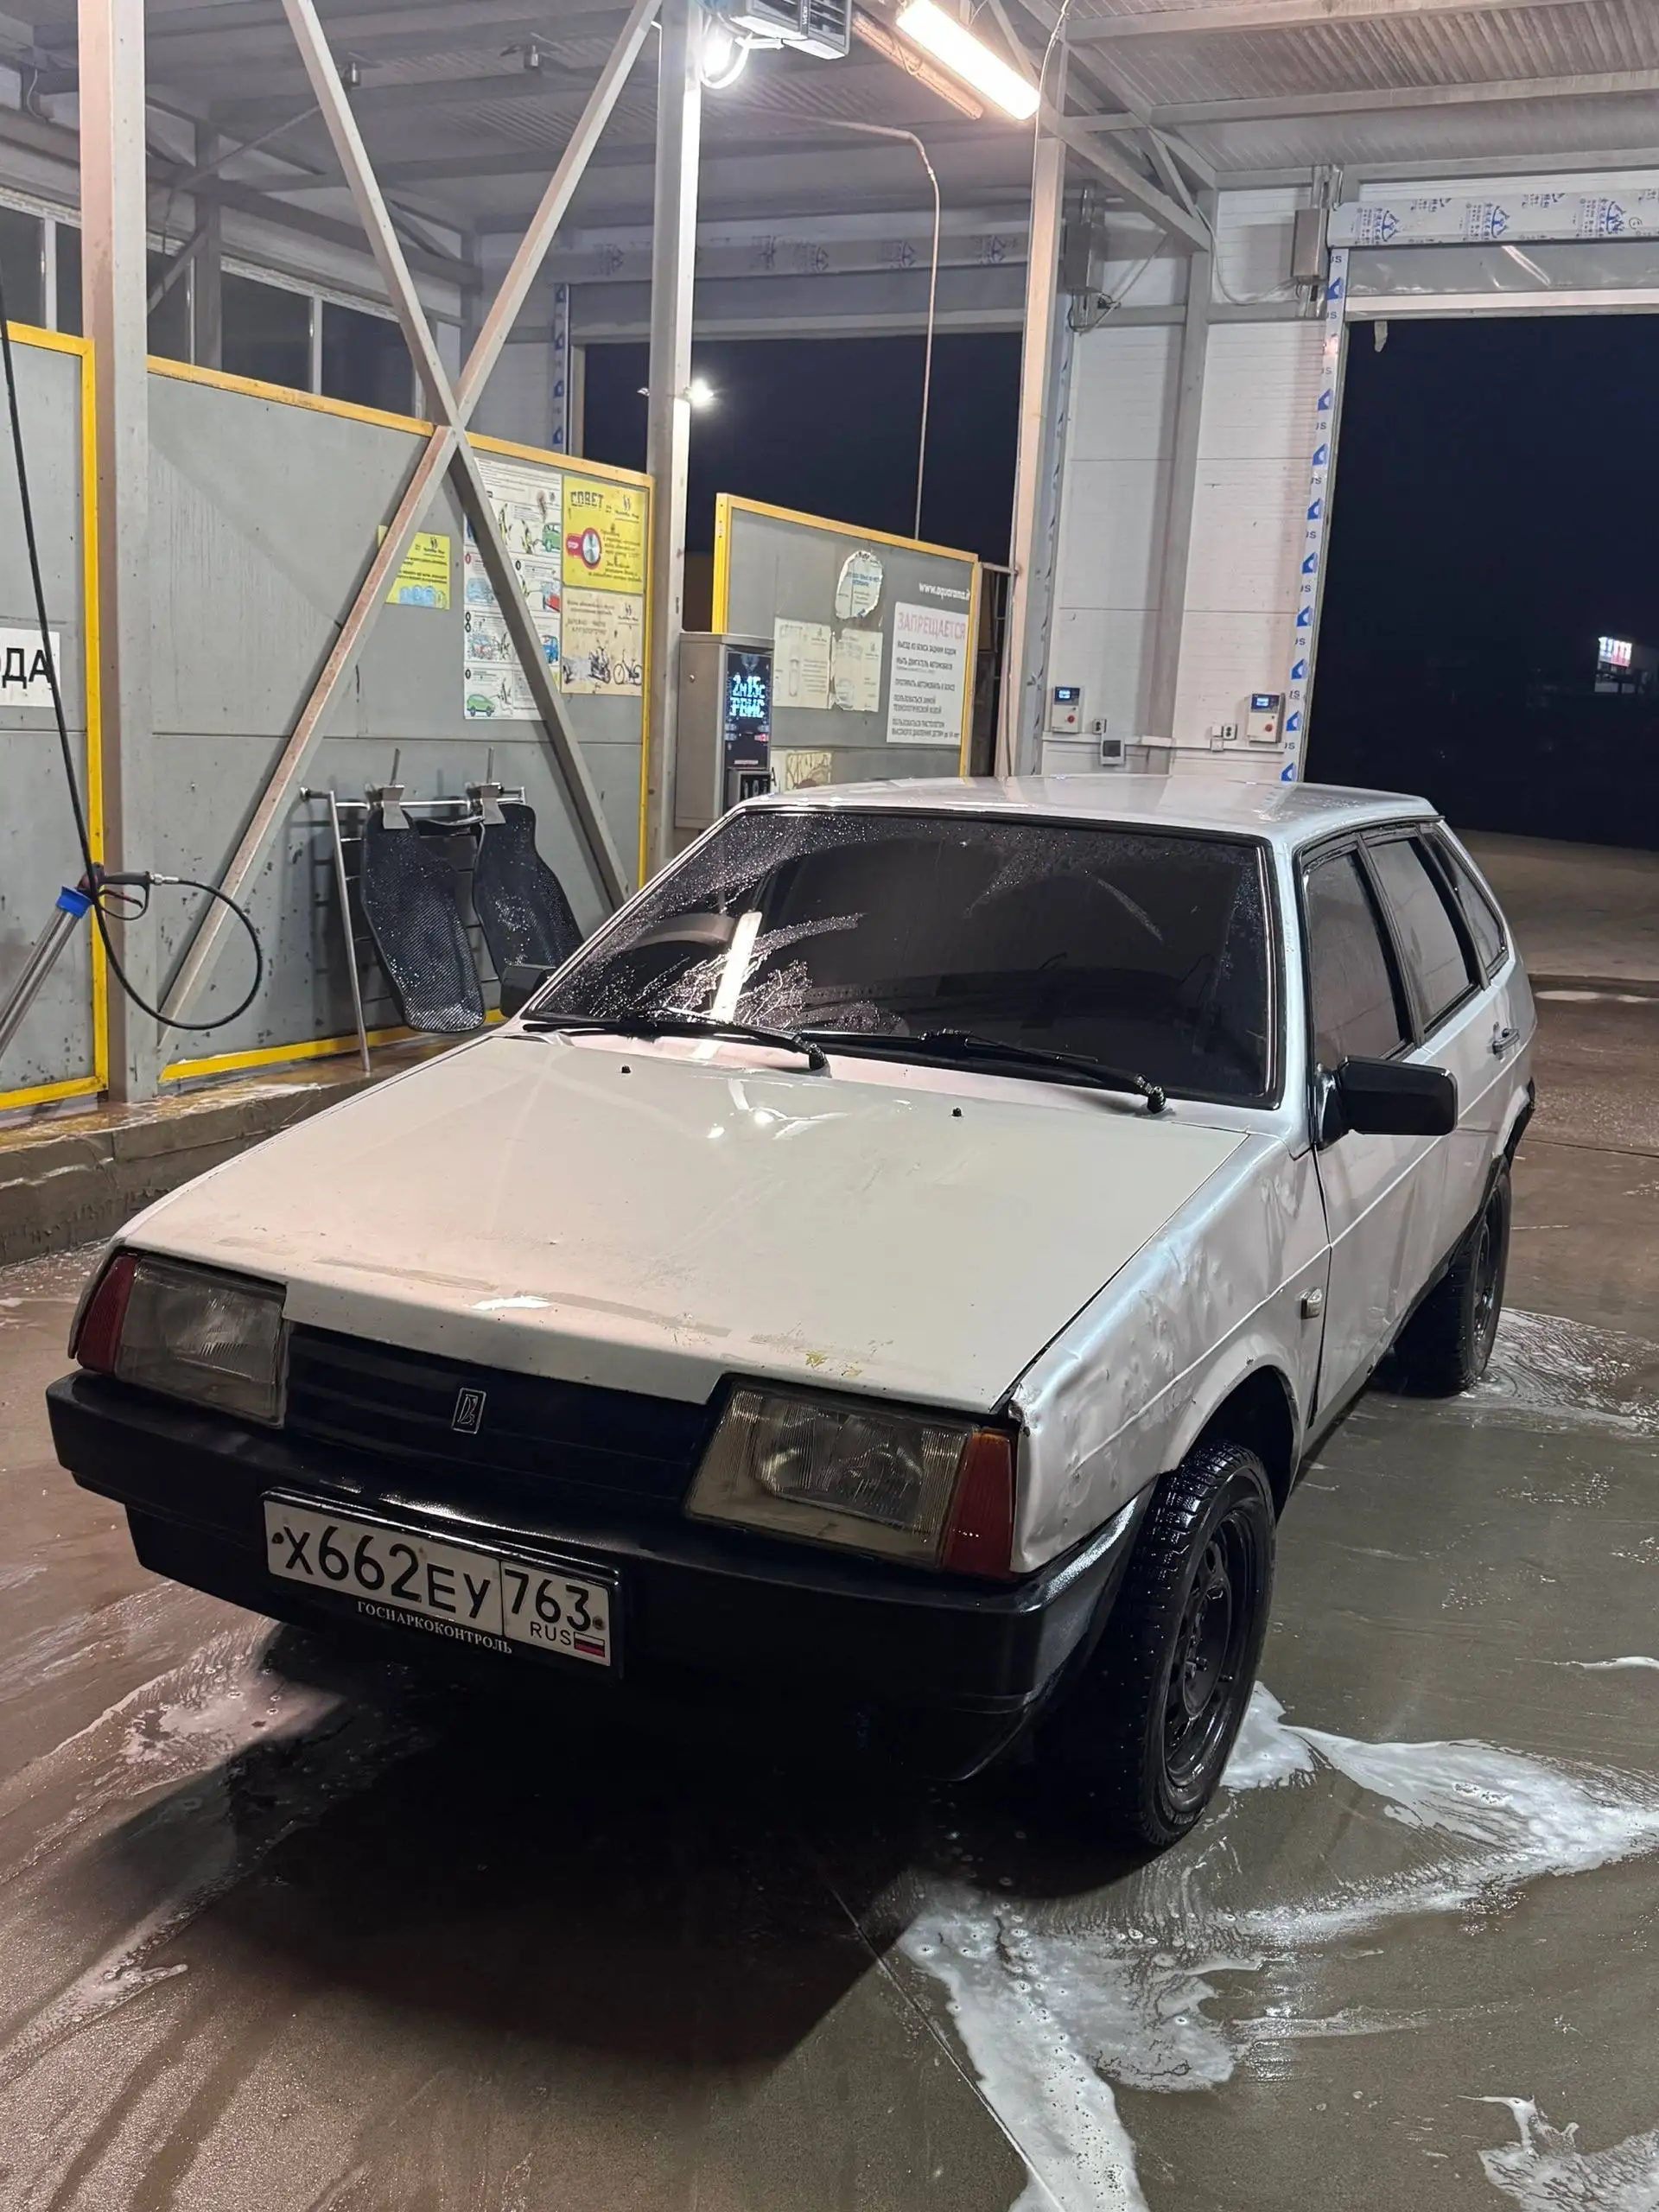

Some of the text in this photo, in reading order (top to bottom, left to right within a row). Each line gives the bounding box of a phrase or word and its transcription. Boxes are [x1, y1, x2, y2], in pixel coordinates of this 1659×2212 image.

[897, 611, 967, 640] ЗАПРЕЩАЕТСЯ
[0, 647, 54, 690] ДА
[283, 1525, 592, 1632] Х662ЕУ 763
[356, 1600, 513, 1655] ГОСНАРКОКОНТРОЛЬ
[530, 1620, 572, 1646] RUS
